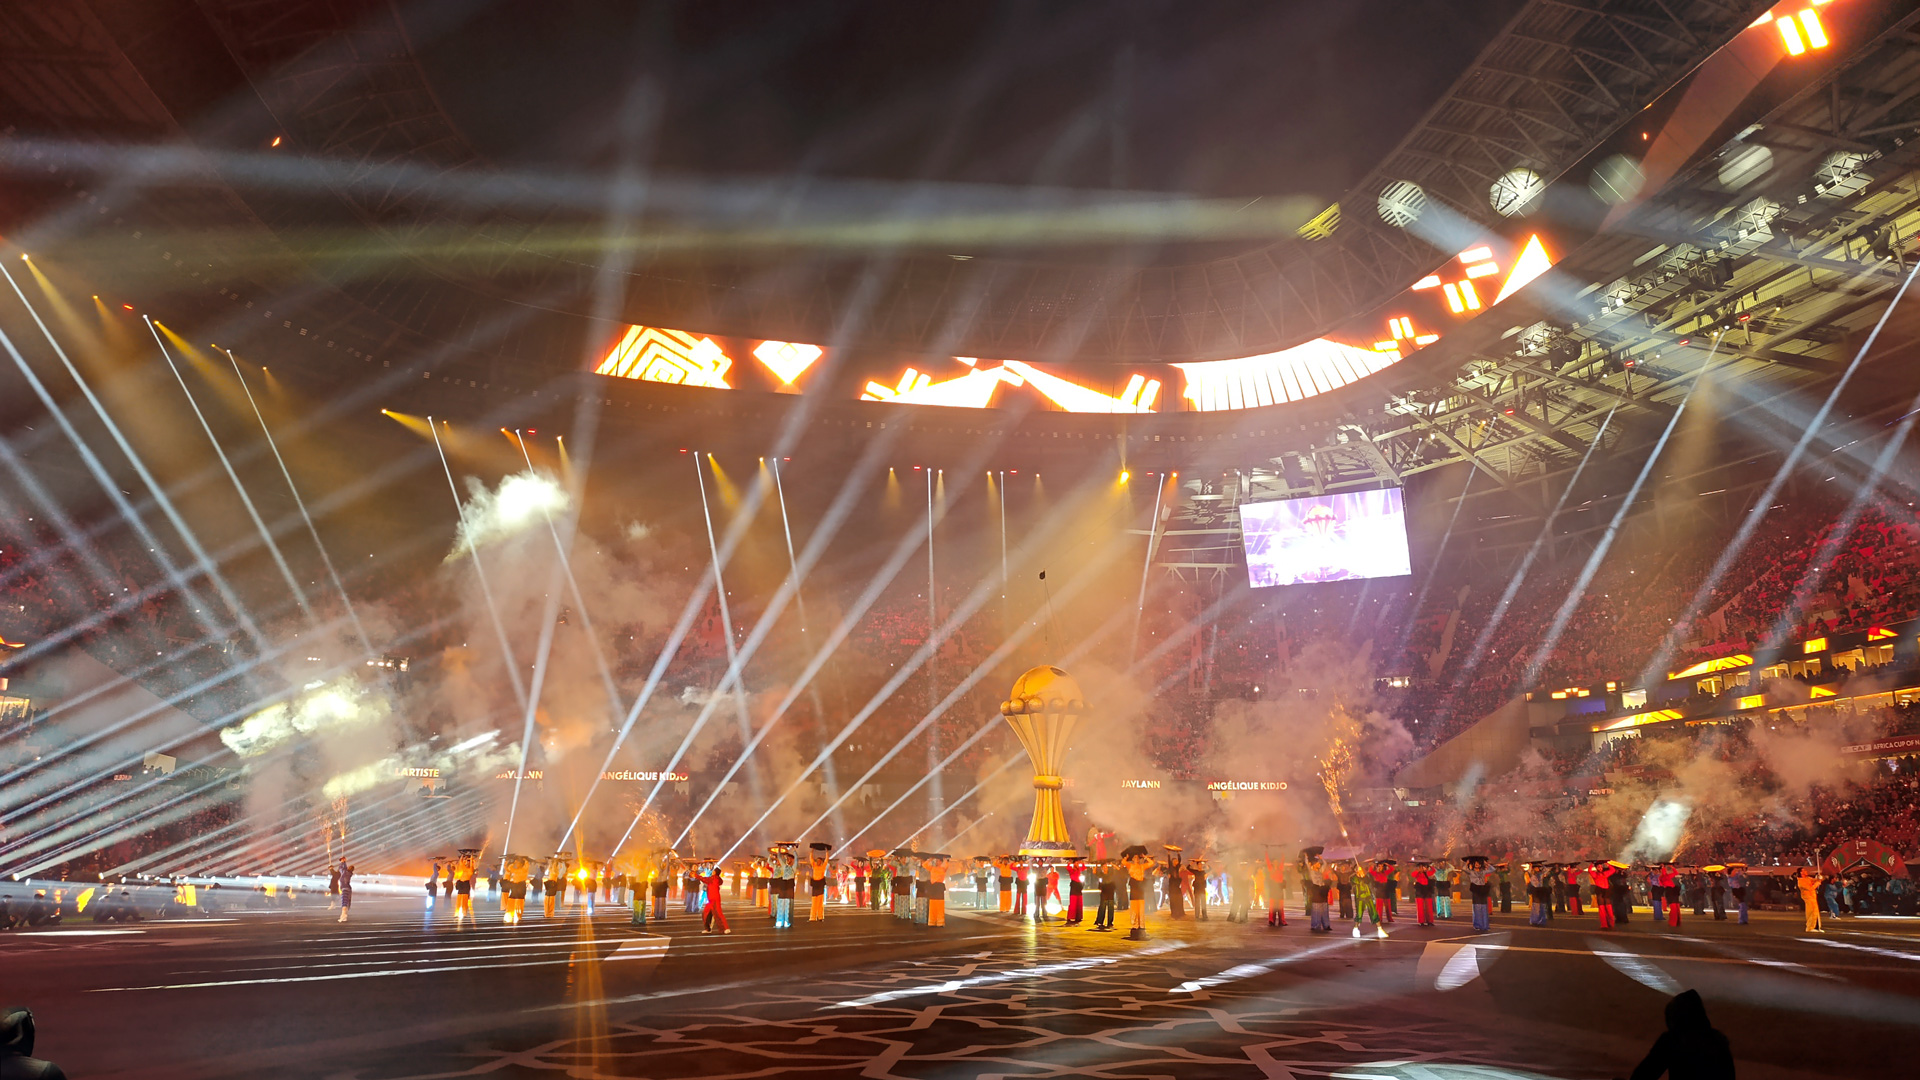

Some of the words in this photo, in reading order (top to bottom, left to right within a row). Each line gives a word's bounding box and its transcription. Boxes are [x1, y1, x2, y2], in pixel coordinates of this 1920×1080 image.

[1873, 742, 1894, 750] AFRICA
[1894, 740, 1905, 748] CUP
[600, 770, 657, 781] ANGÉLIQUE
[1122, 780, 1160, 788] JAYLANN
[1208, 780, 1258, 790] ANGÉLIQUE
[1260, 782, 1288, 790] KIDJO
